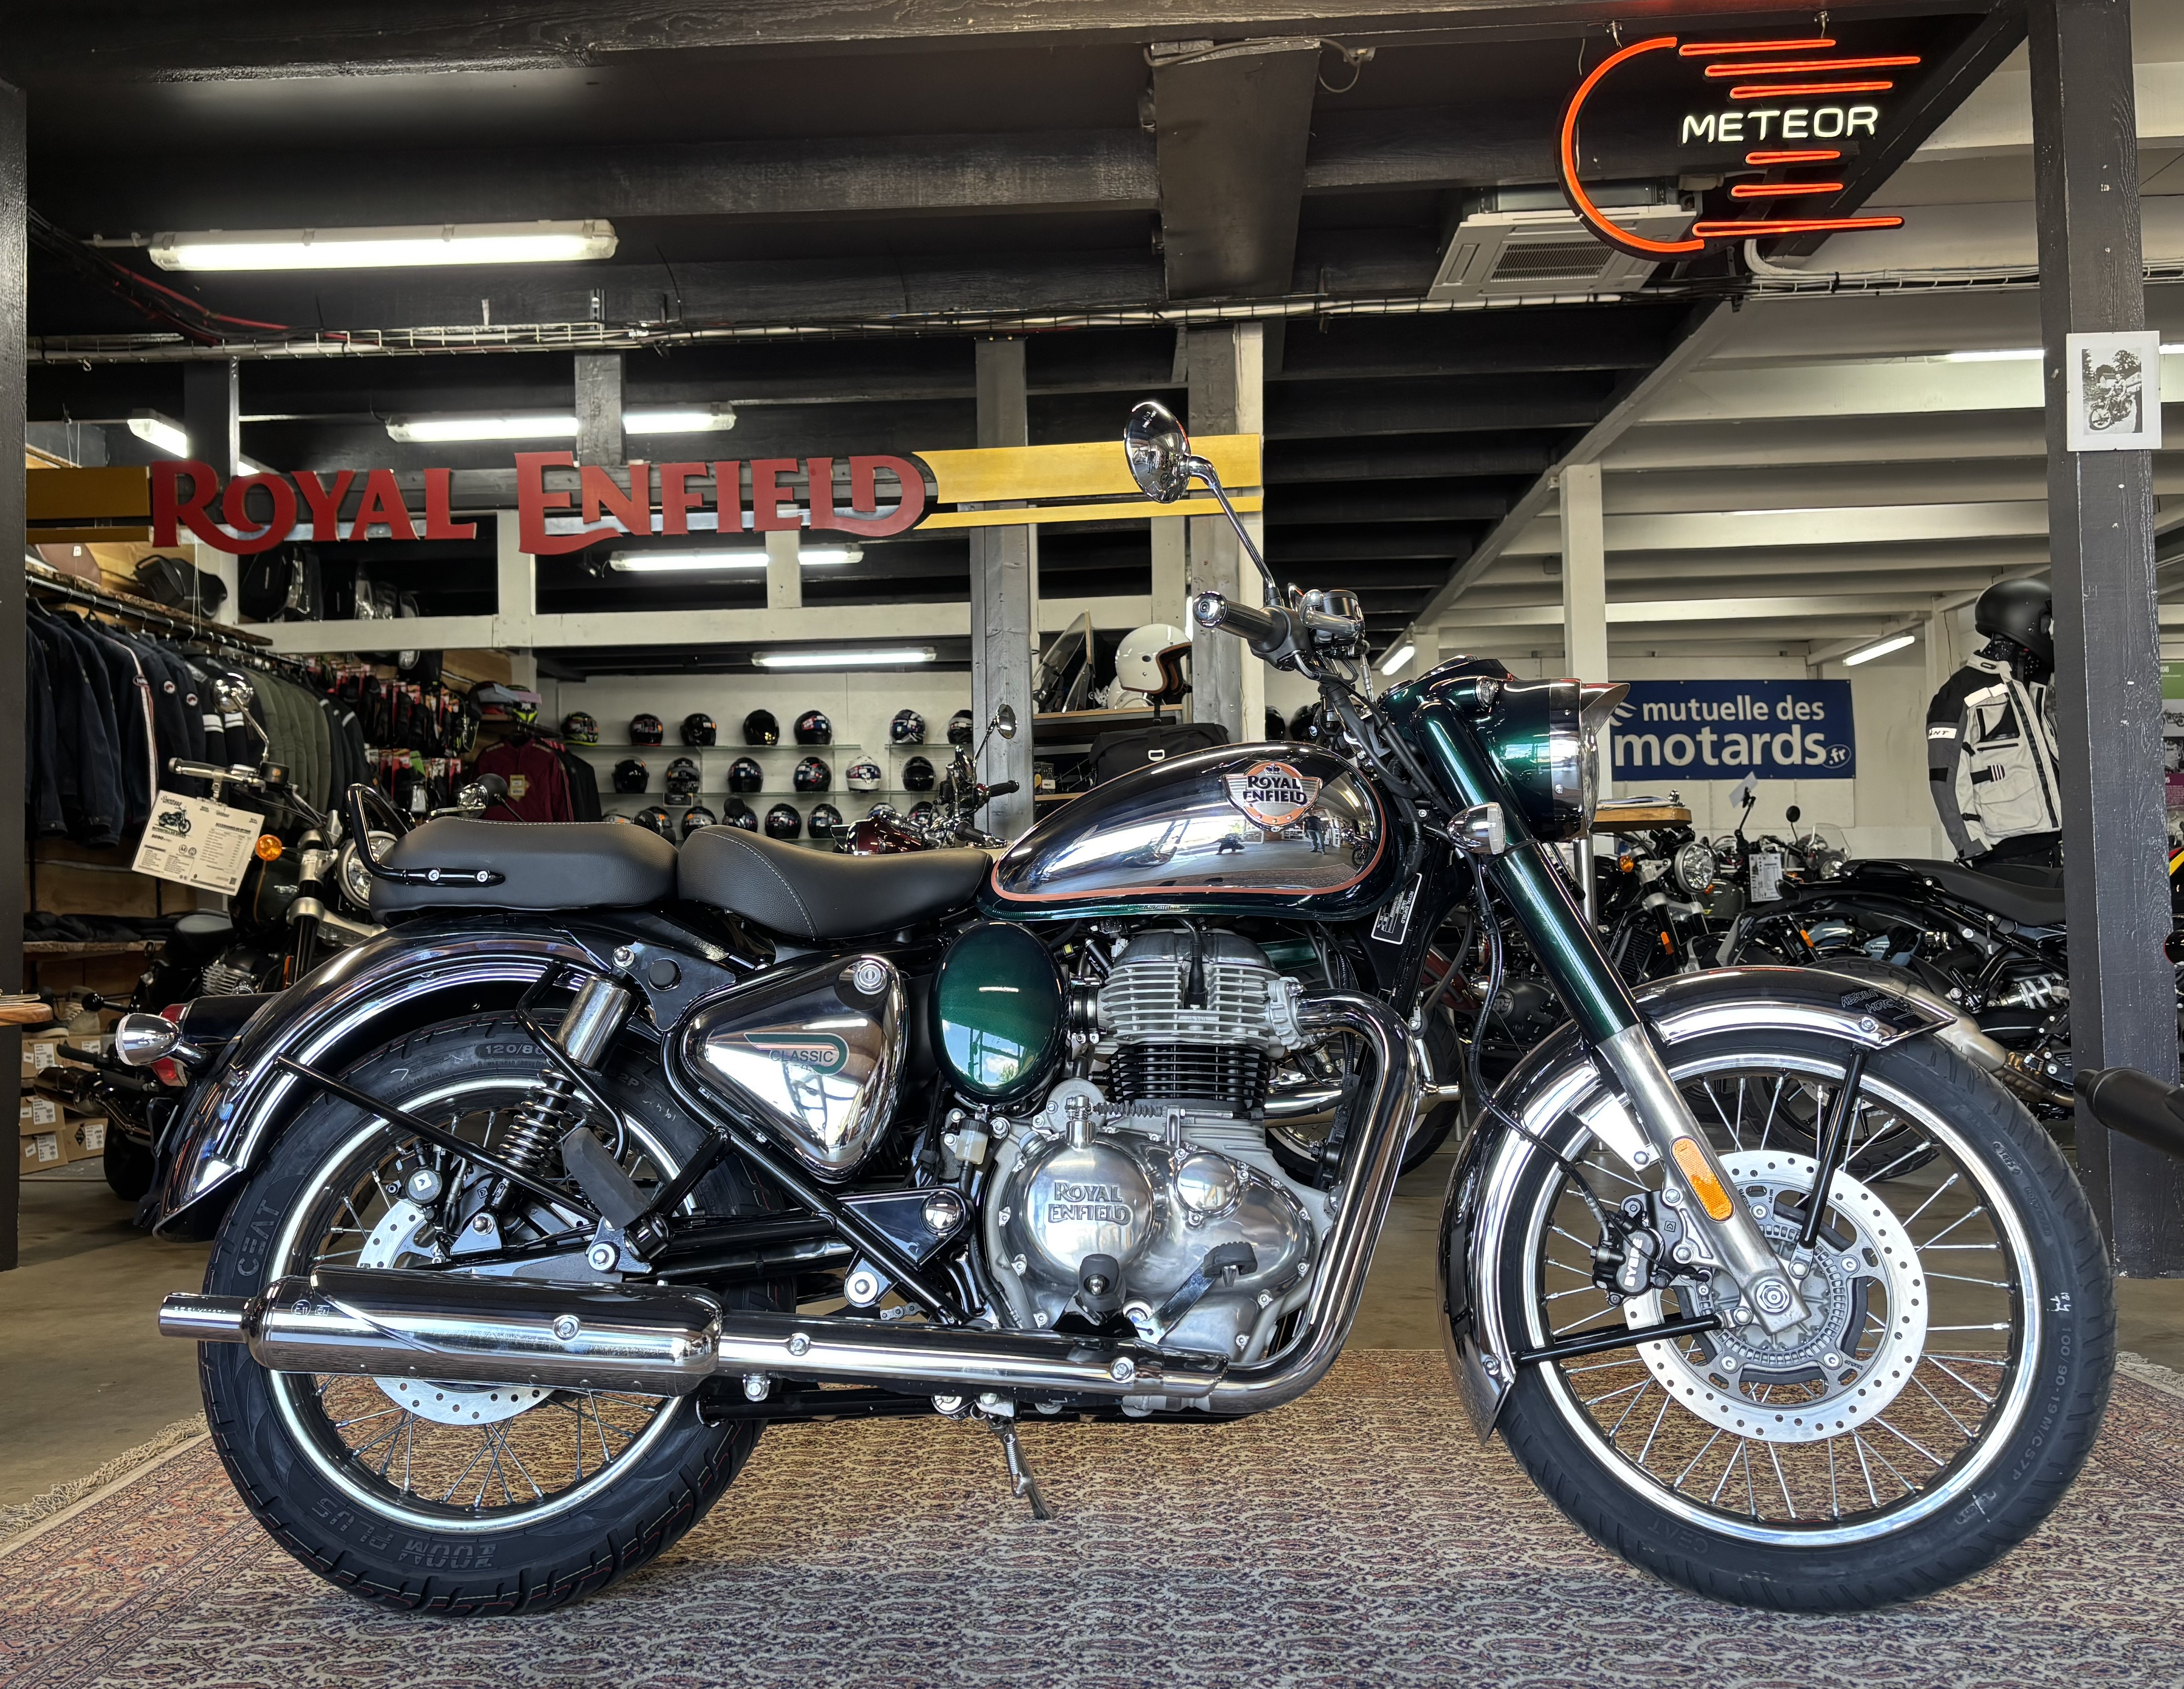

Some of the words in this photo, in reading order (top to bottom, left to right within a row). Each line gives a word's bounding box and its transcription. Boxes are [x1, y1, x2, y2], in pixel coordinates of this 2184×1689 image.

[1682, 106, 1879, 144] METEOR
[152, 460, 477, 554] ROYAL
[514, 451, 925, 555] ENFIELD
[1642, 694, 1769, 721] mutuelle
[1776, 694, 1825, 721] des
[1614, 724, 1827, 767] motards
[1829, 747, 1847, 765] .fr
[1243, 790, 1308, 805] ENFIELD
[1247, 775, 1300, 790] ROYAL
[771, 1049, 833, 1063] CLASSIC
[1054, 1180, 1123, 1203] ROYAL
[1048, 1204, 1131, 1226] ENFIELD
[237, 1199, 280, 1277] CEAT
[2047, 1326, 2071, 1413] 100/90-19
[311, 1498, 395, 1550] PLUS
[398, 1539, 497, 1569] ZOOM
